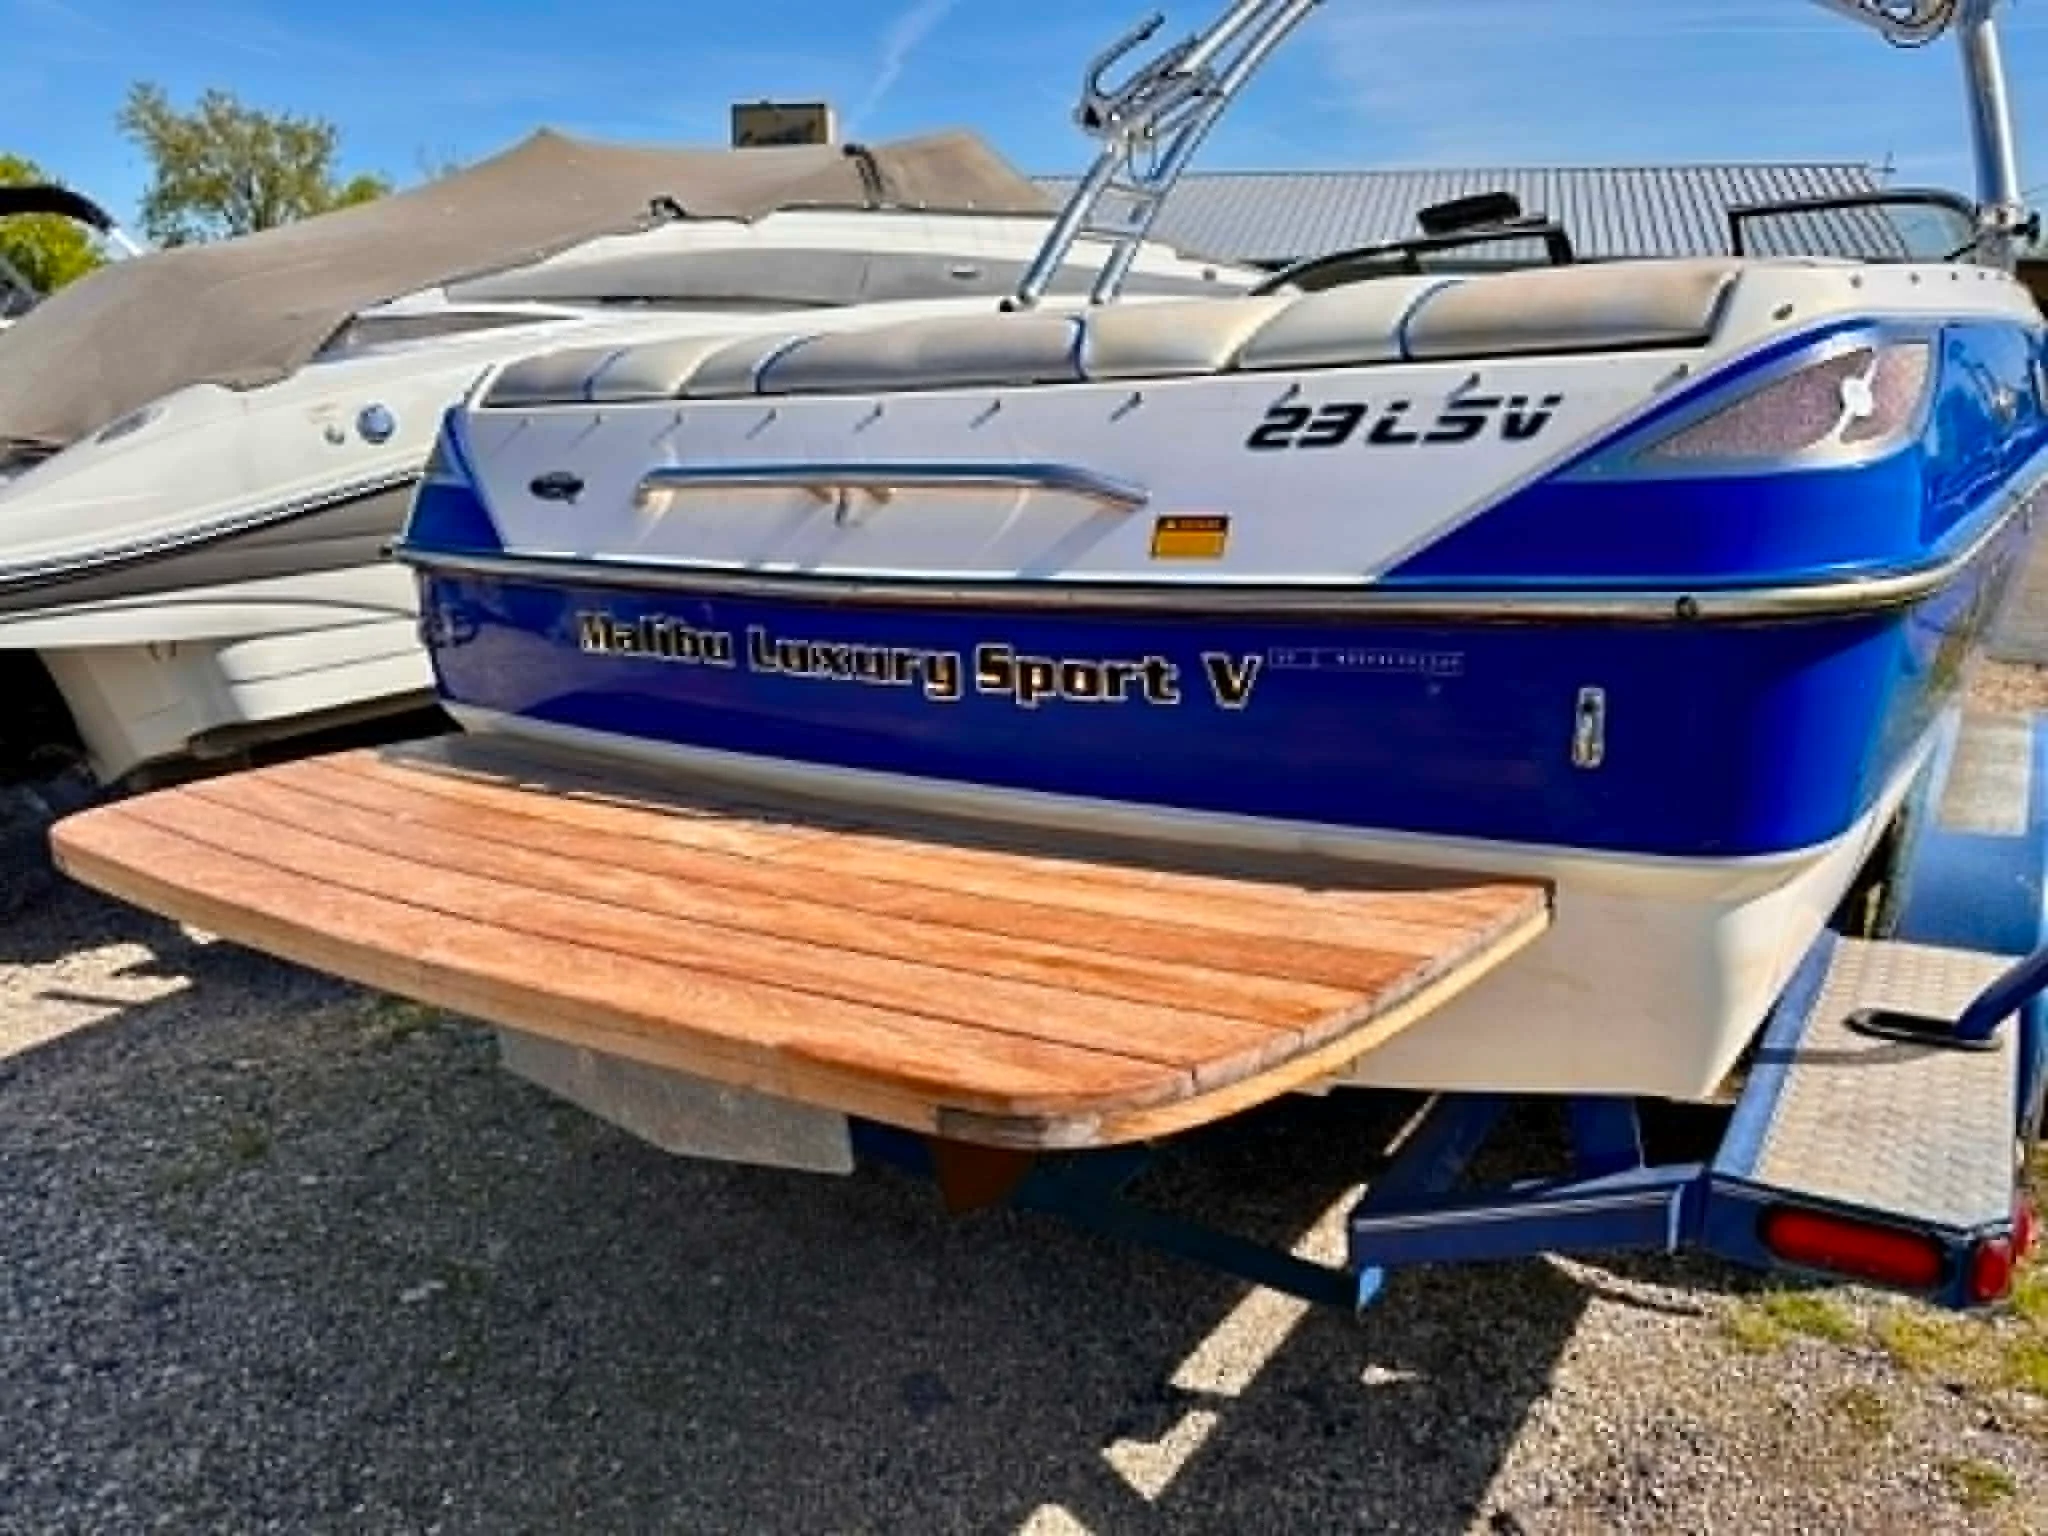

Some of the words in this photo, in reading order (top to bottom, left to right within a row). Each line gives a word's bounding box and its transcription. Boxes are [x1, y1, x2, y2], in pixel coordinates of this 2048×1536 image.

[1246, 403, 1369, 449] 23
[576, 611, 734, 668] Malibu
[748, 625, 962, 700] Luxury
[976, 643, 1180, 708] Sport
[1201, 652, 1262, 709] V
